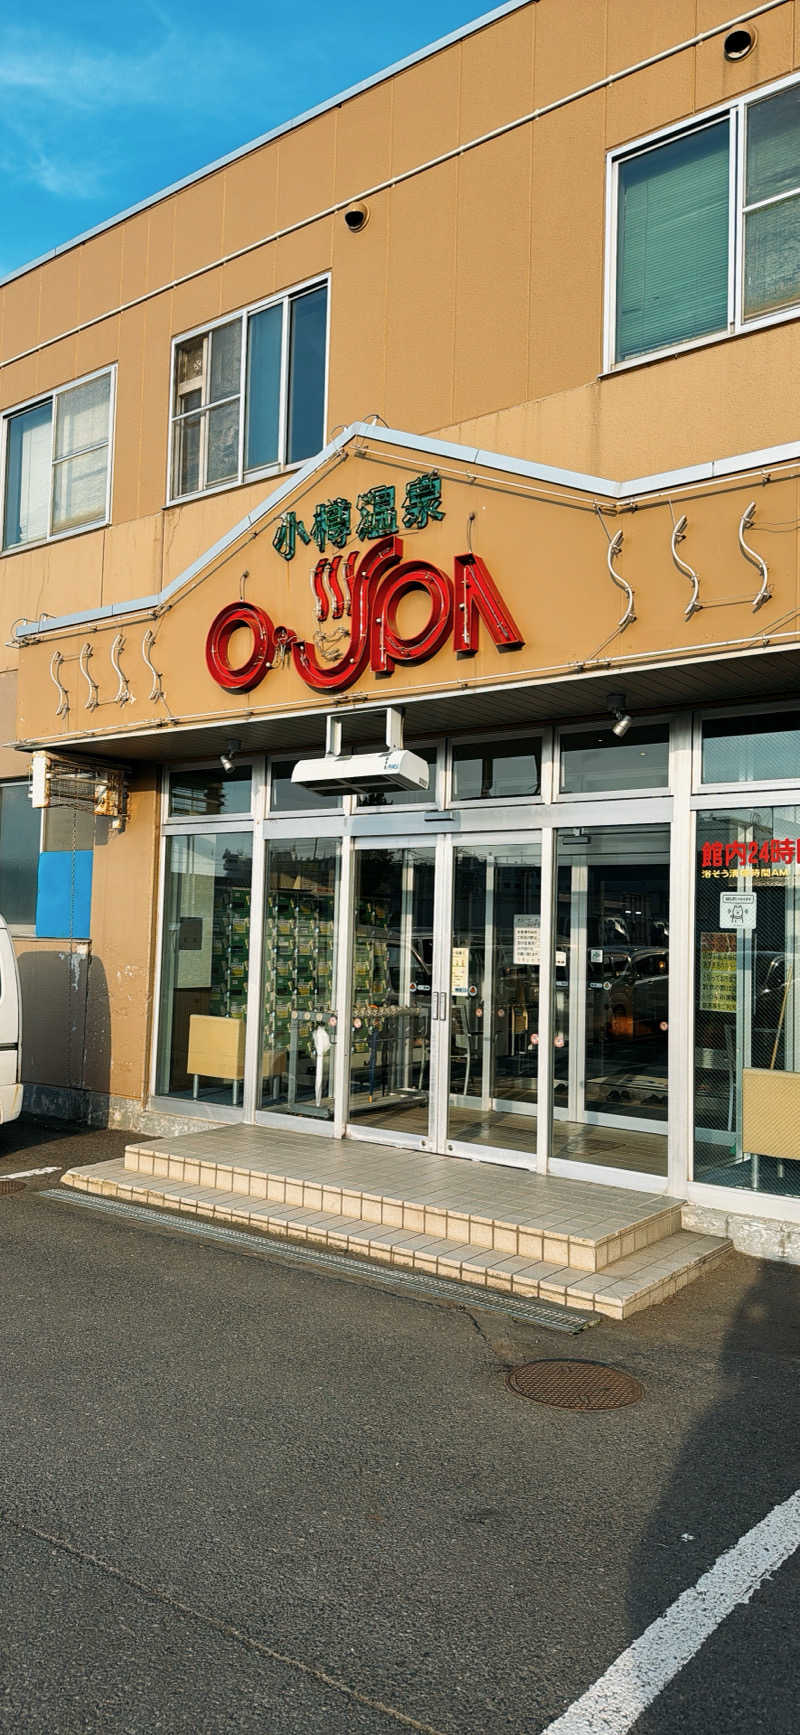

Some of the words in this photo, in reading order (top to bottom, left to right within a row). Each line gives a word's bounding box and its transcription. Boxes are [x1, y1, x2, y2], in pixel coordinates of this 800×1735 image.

[272, 470, 446, 560] 小樽温泉
[701, 838, 800, 867] 館内24時
